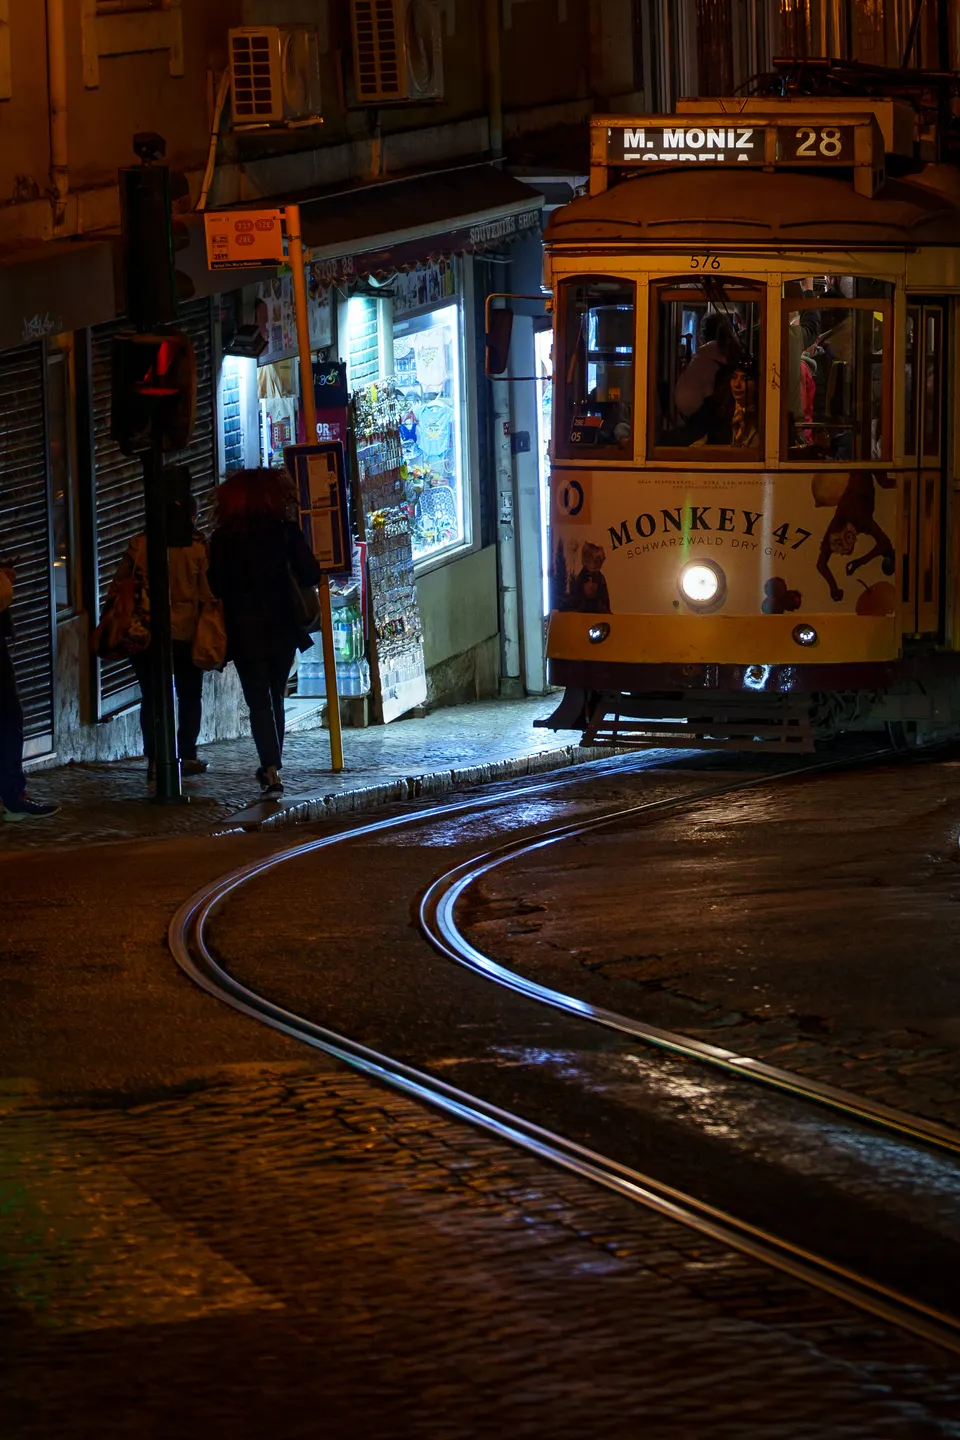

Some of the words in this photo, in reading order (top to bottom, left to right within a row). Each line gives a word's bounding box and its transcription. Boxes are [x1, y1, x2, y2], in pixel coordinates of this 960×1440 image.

[623, 128, 654, 149] M.
[663, 128, 754, 149] MONIZ
[795, 127, 842, 157] 28
[469, 216, 516, 244] SOUVENIRS
[518, 210, 540, 230] SHOP
[314, 259, 338, 279] STOP
[341, 256, 354, 274] 28
[689, 254, 721, 270] 576
[570, 431, 582, 442] 05
[607, 506, 763, 550] MONKEY
[772, 522, 812, 550] 47
[627, 536, 724, 559] SCHWARZWALD
[731, 539, 758, 552] DRY
[764, 546, 787, 561] GIN
